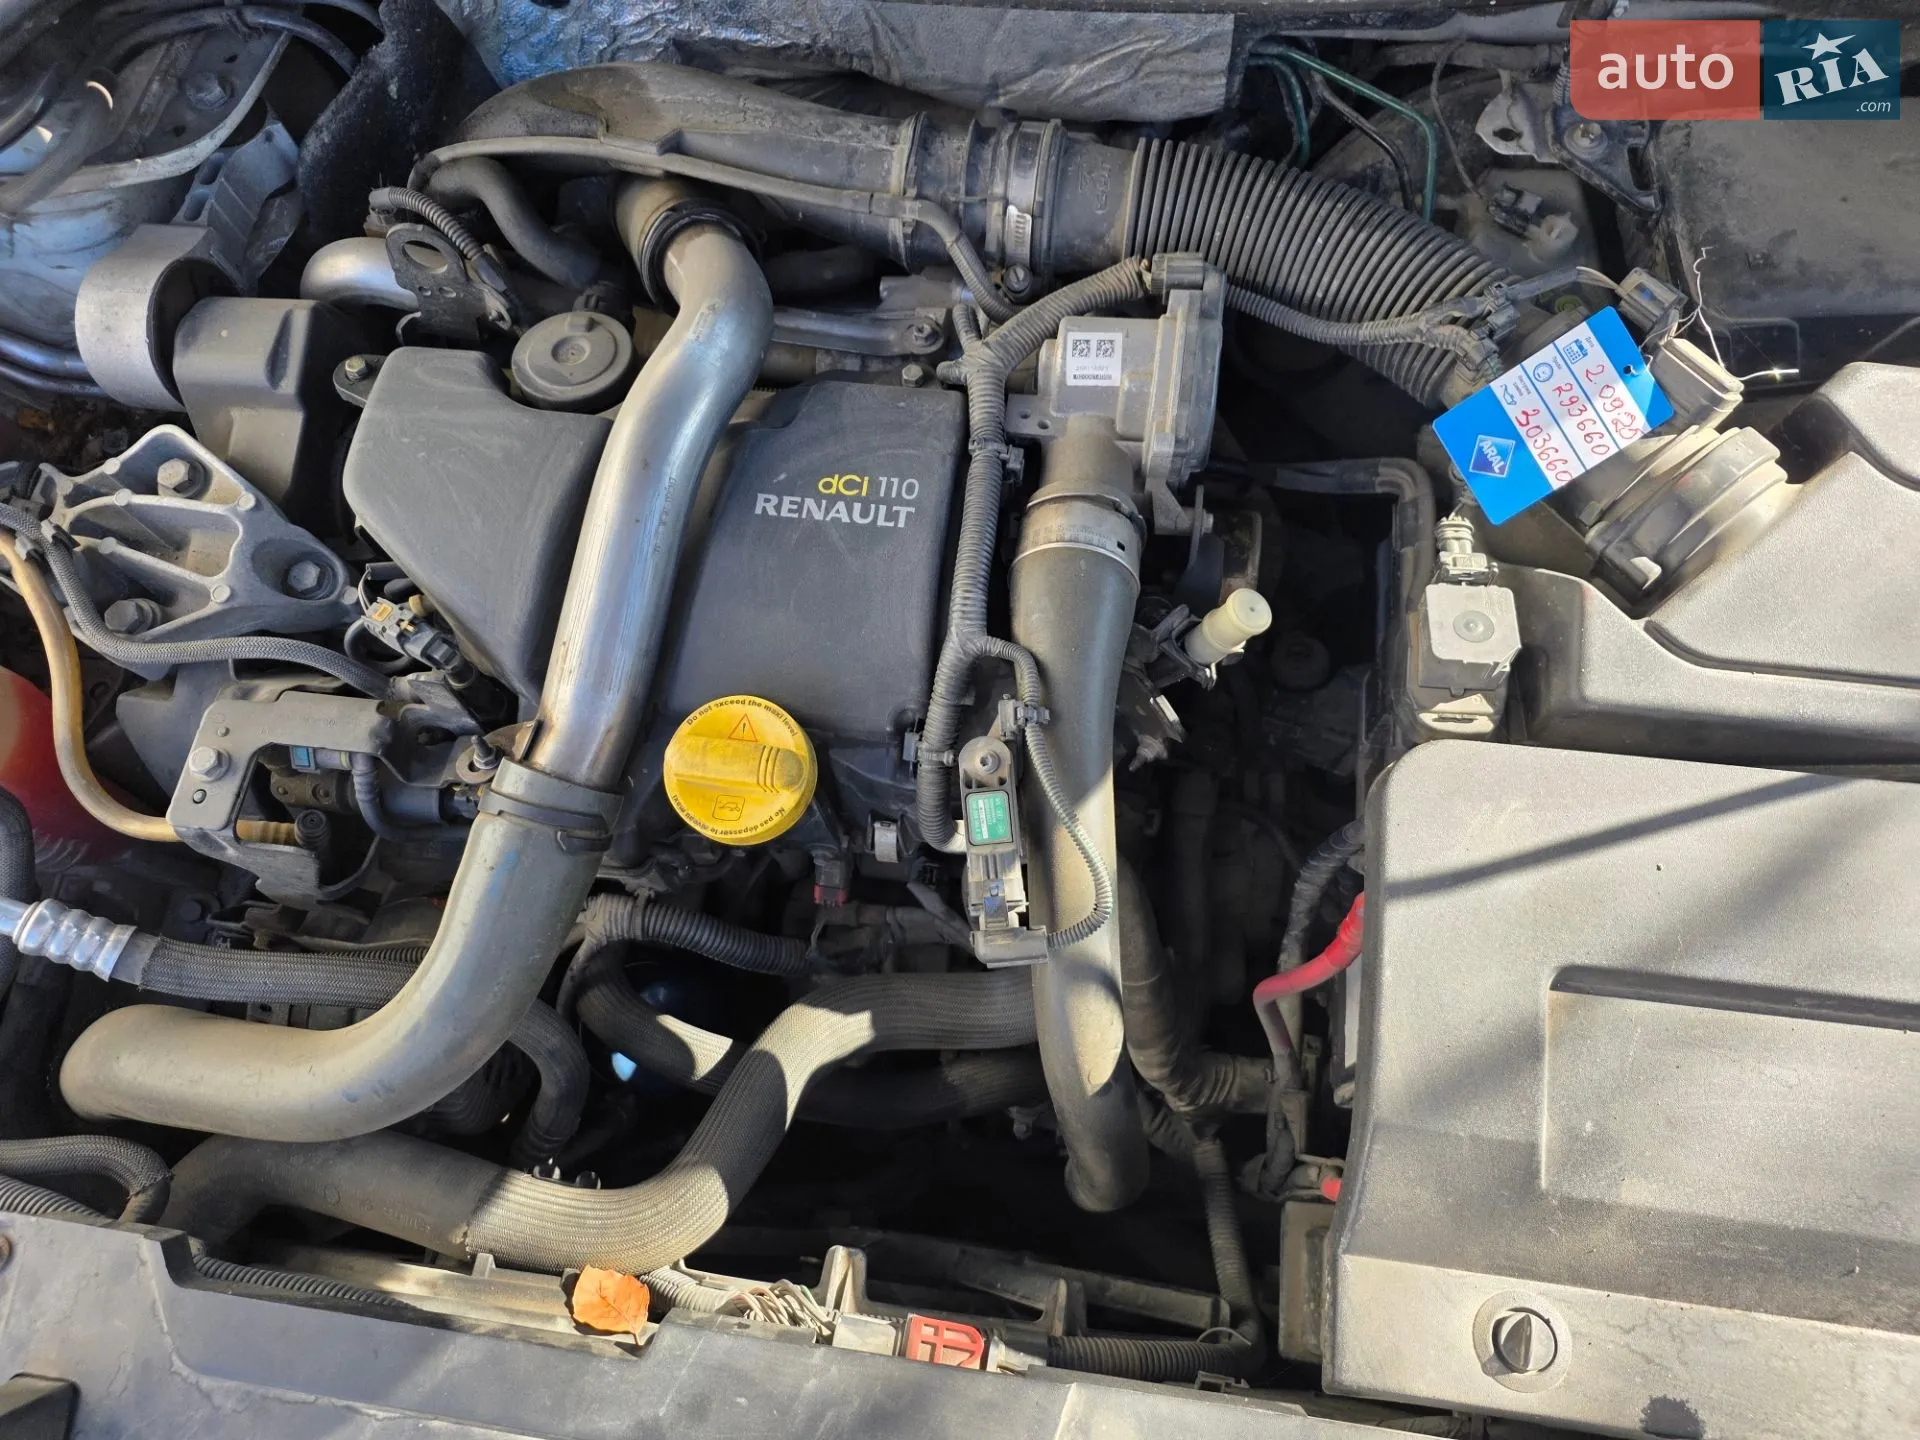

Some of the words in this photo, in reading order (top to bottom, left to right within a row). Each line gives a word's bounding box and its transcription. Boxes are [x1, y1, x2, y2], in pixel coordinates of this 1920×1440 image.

[1478, 438, 1506, 474] ARAL
[818, 473, 870, 497] dCi
[878, 476, 919, 500] 110
[754, 492, 915, 528] RENAULT
[686, 714, 698, 726] Do
[698, 705, 713, 717] not
[748, 699, 762, 708] the
[763, 704, 784, 720] maxi
[782, 717, 797, 737] level
[710, 827, 719, 835] le
[759, 815, 774, 827] pas
